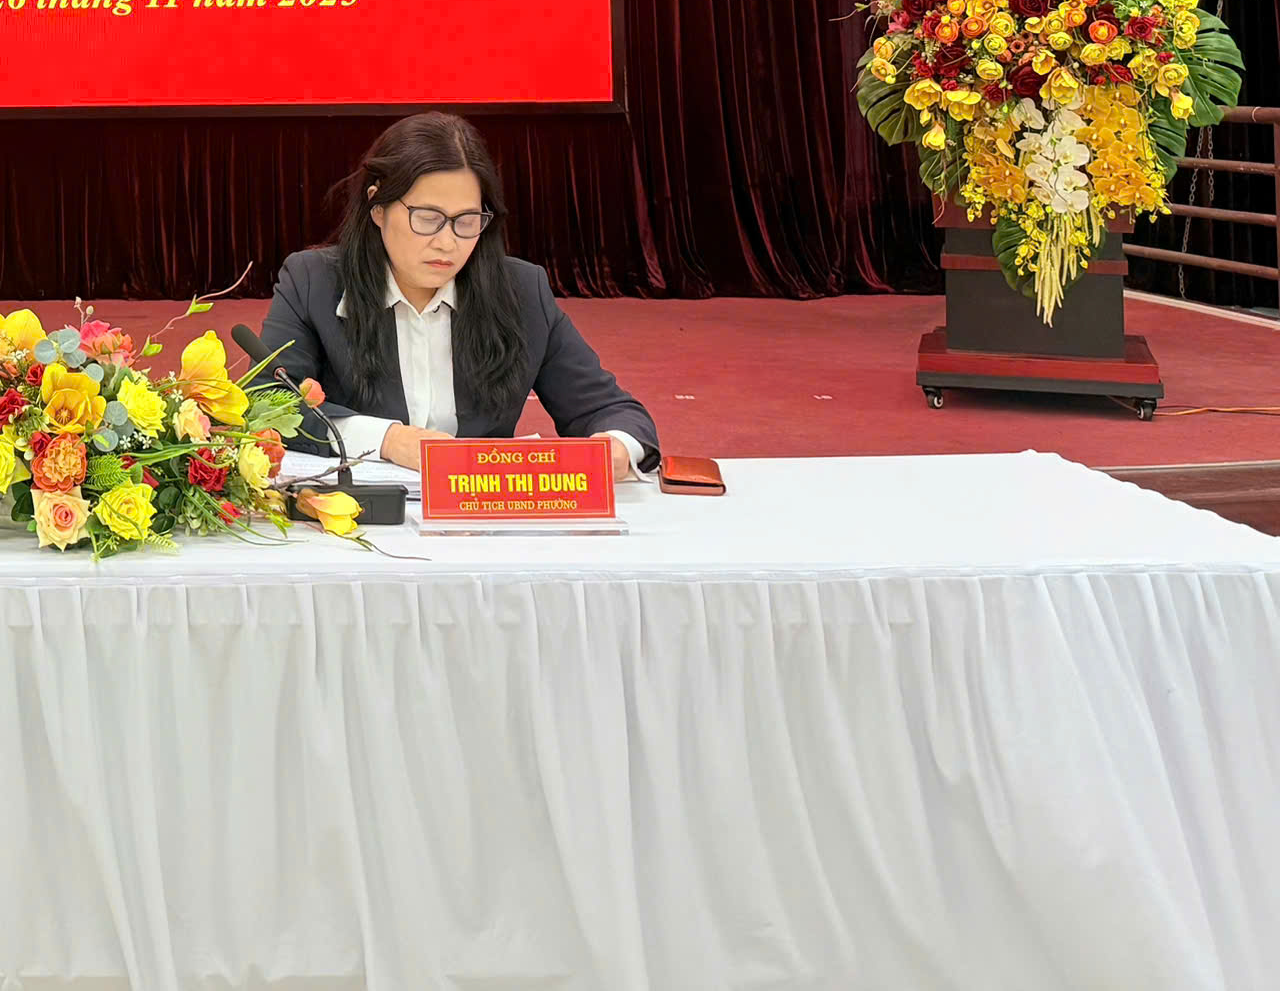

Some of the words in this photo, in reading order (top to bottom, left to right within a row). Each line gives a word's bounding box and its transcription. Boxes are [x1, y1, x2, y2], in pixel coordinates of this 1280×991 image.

[477, 448, 524, 464] ĐỒNG
[527, 448, 556, 464] CHÍ
[447, 474, 501, 497] TRỊNH
[505, 473, 534, 497] THỊ
[538, 472, 588, 493] DUNG
[459, 497, 480, 511] CHỦ
[482, 499, 506, 512] TỊCH
[508, 499, 535, 510] UBND
[537, 497, 578, 510] PHƯỜNG
